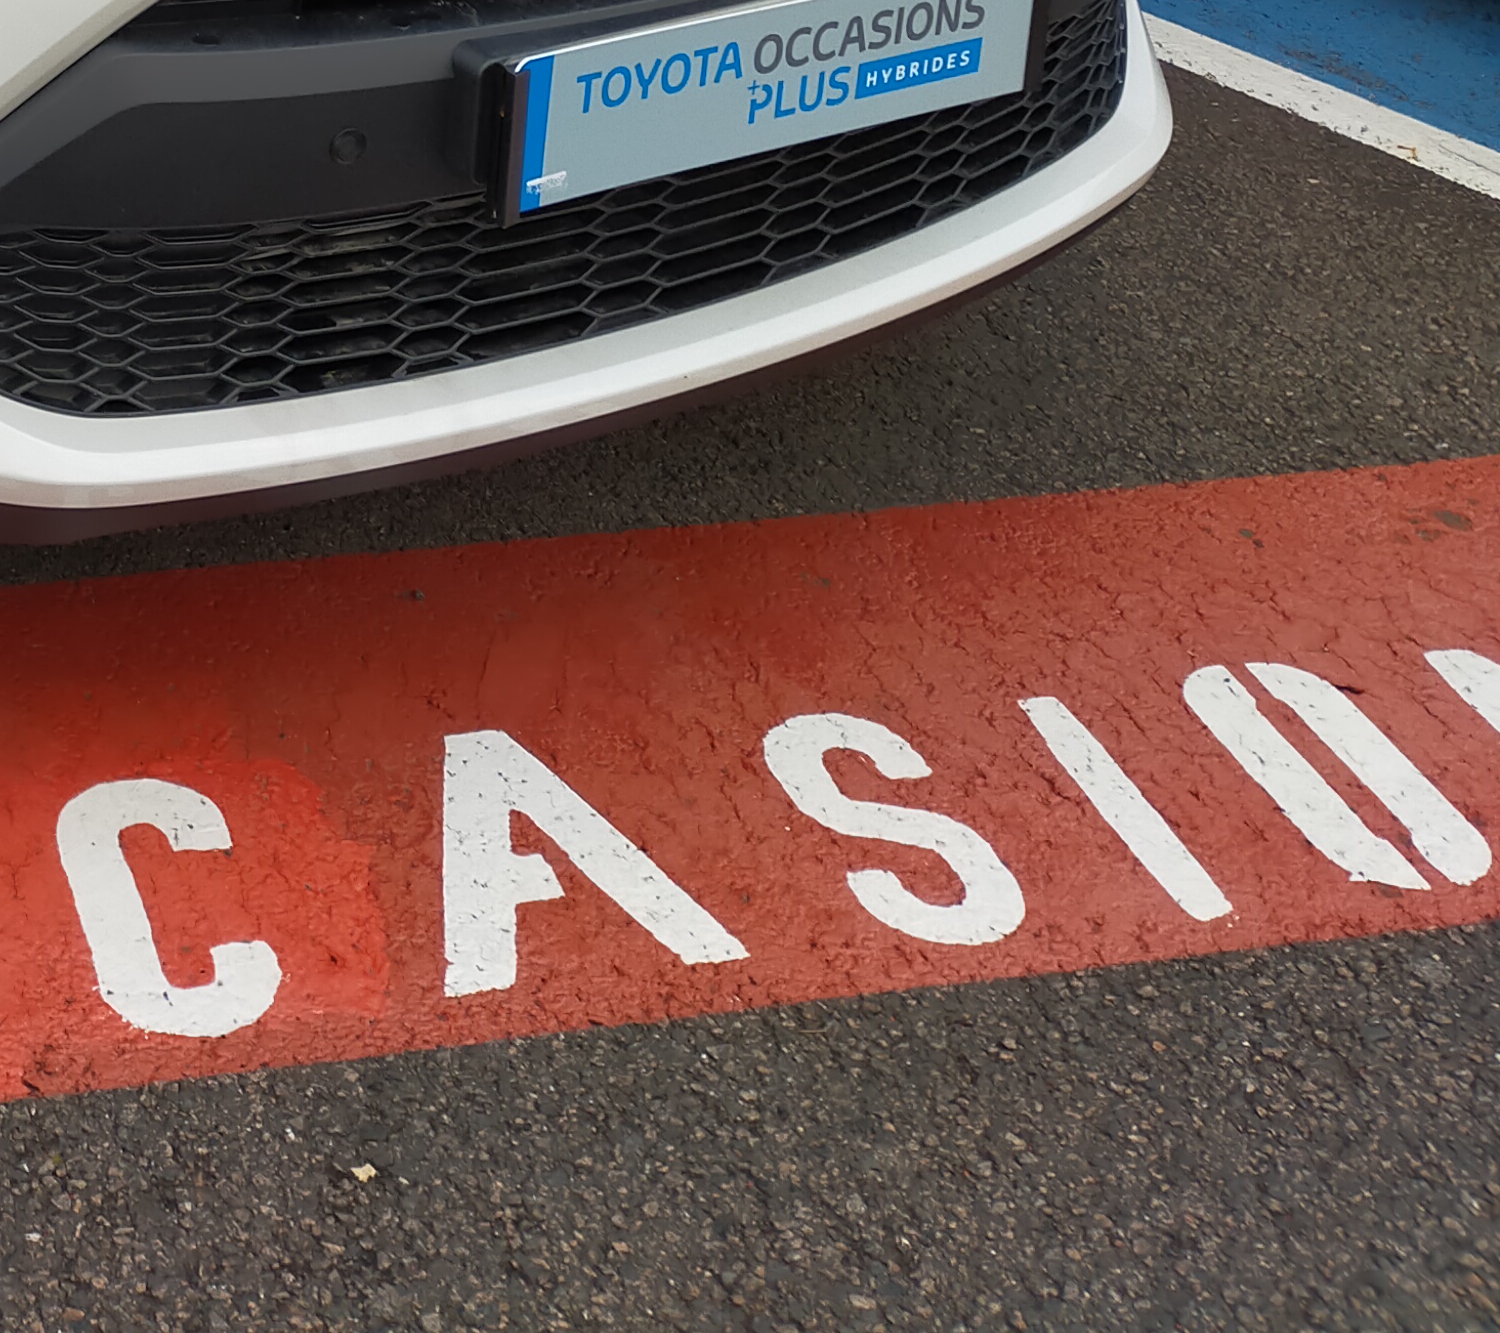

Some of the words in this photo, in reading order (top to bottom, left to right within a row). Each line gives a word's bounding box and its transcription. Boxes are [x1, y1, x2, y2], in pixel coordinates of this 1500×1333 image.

[576, 40, 743, 114] TOYOTA
[745, 65, 851, 125] PLUS
[864, 49, 972, 89] HYBRIDES
